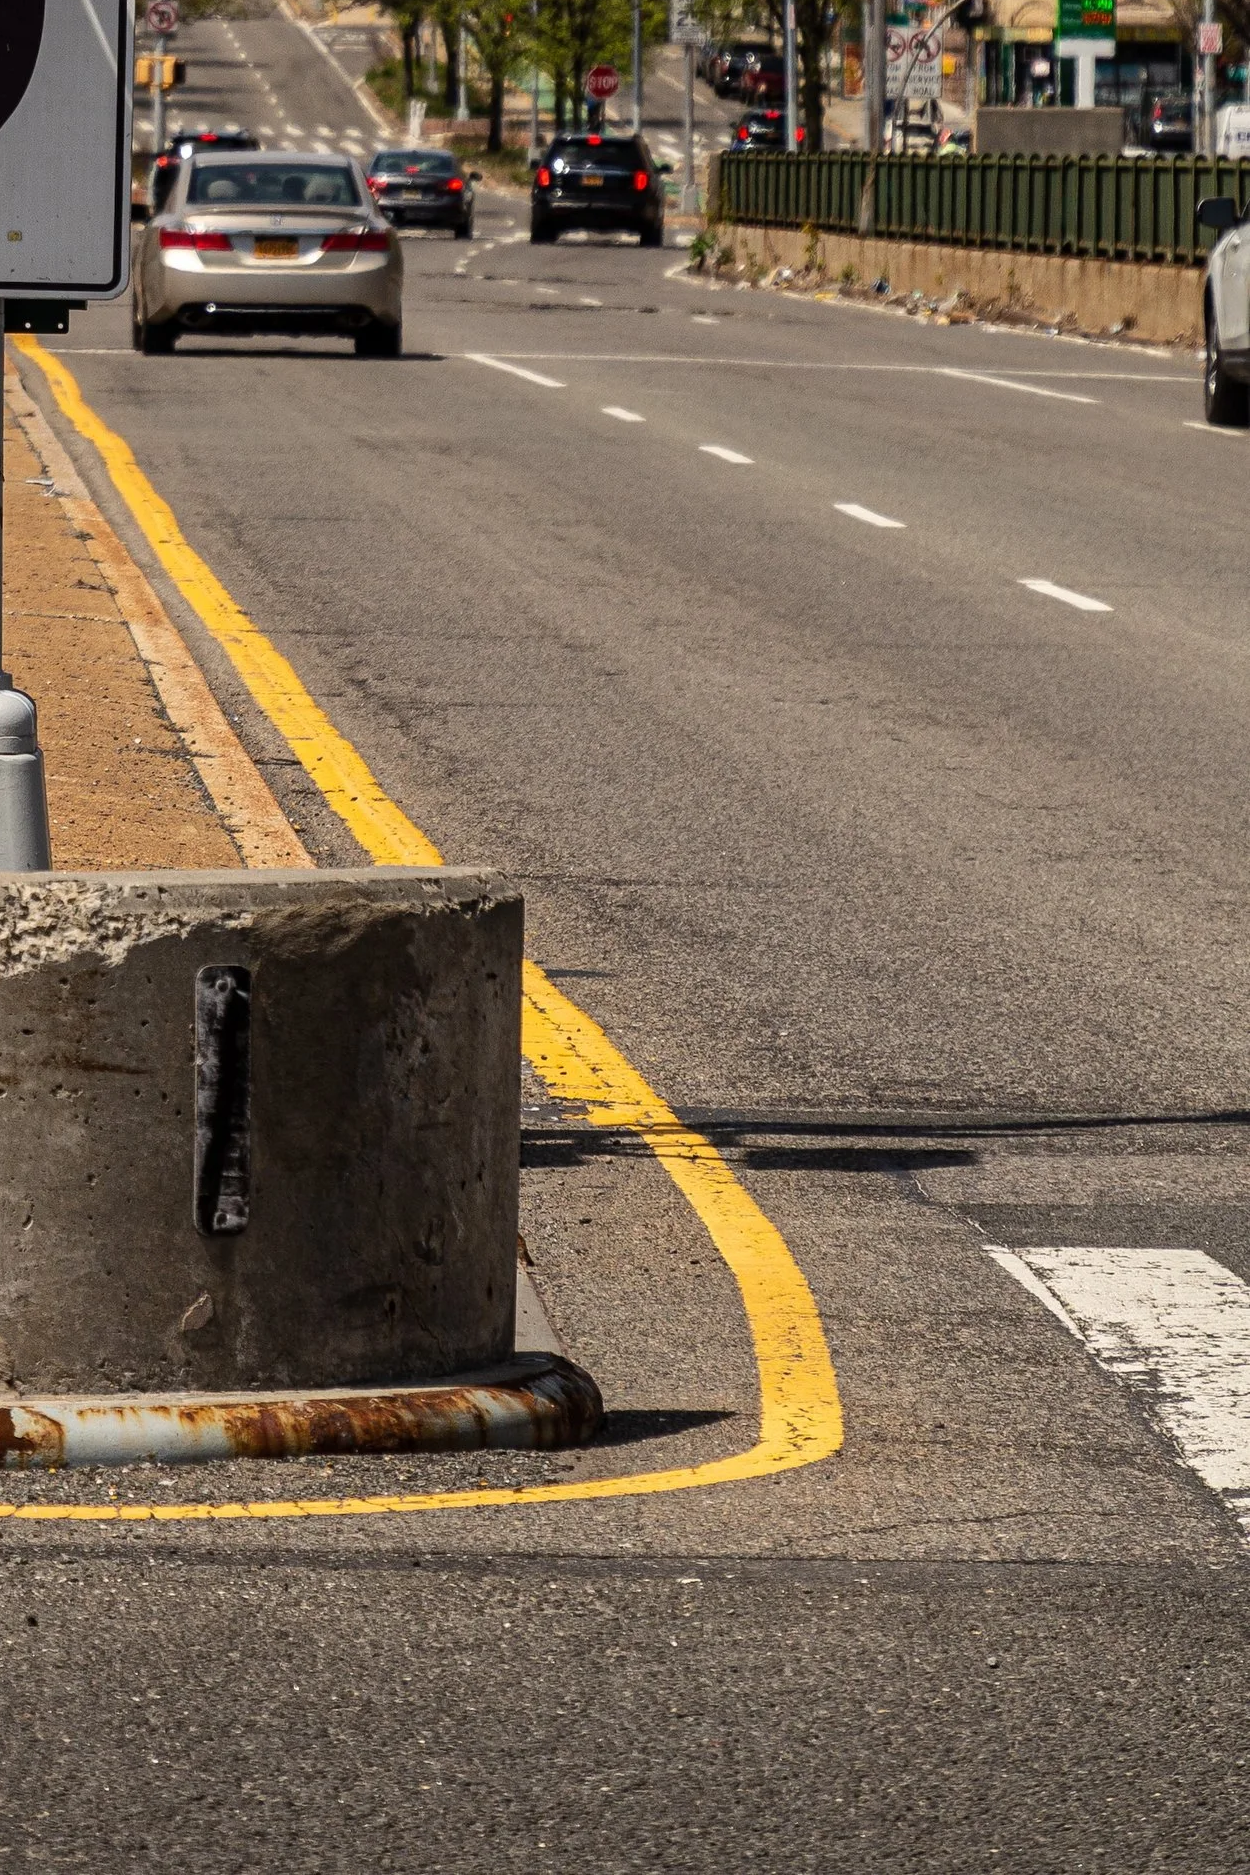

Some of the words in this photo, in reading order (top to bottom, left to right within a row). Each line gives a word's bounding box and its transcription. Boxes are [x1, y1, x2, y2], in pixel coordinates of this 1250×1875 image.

[911, 64, 937, 73] FROM
[590, 75, 618, 89] STOP
[908, 75, 940, 84] SERVICE
[913, 87, 936, 96] ROAD
